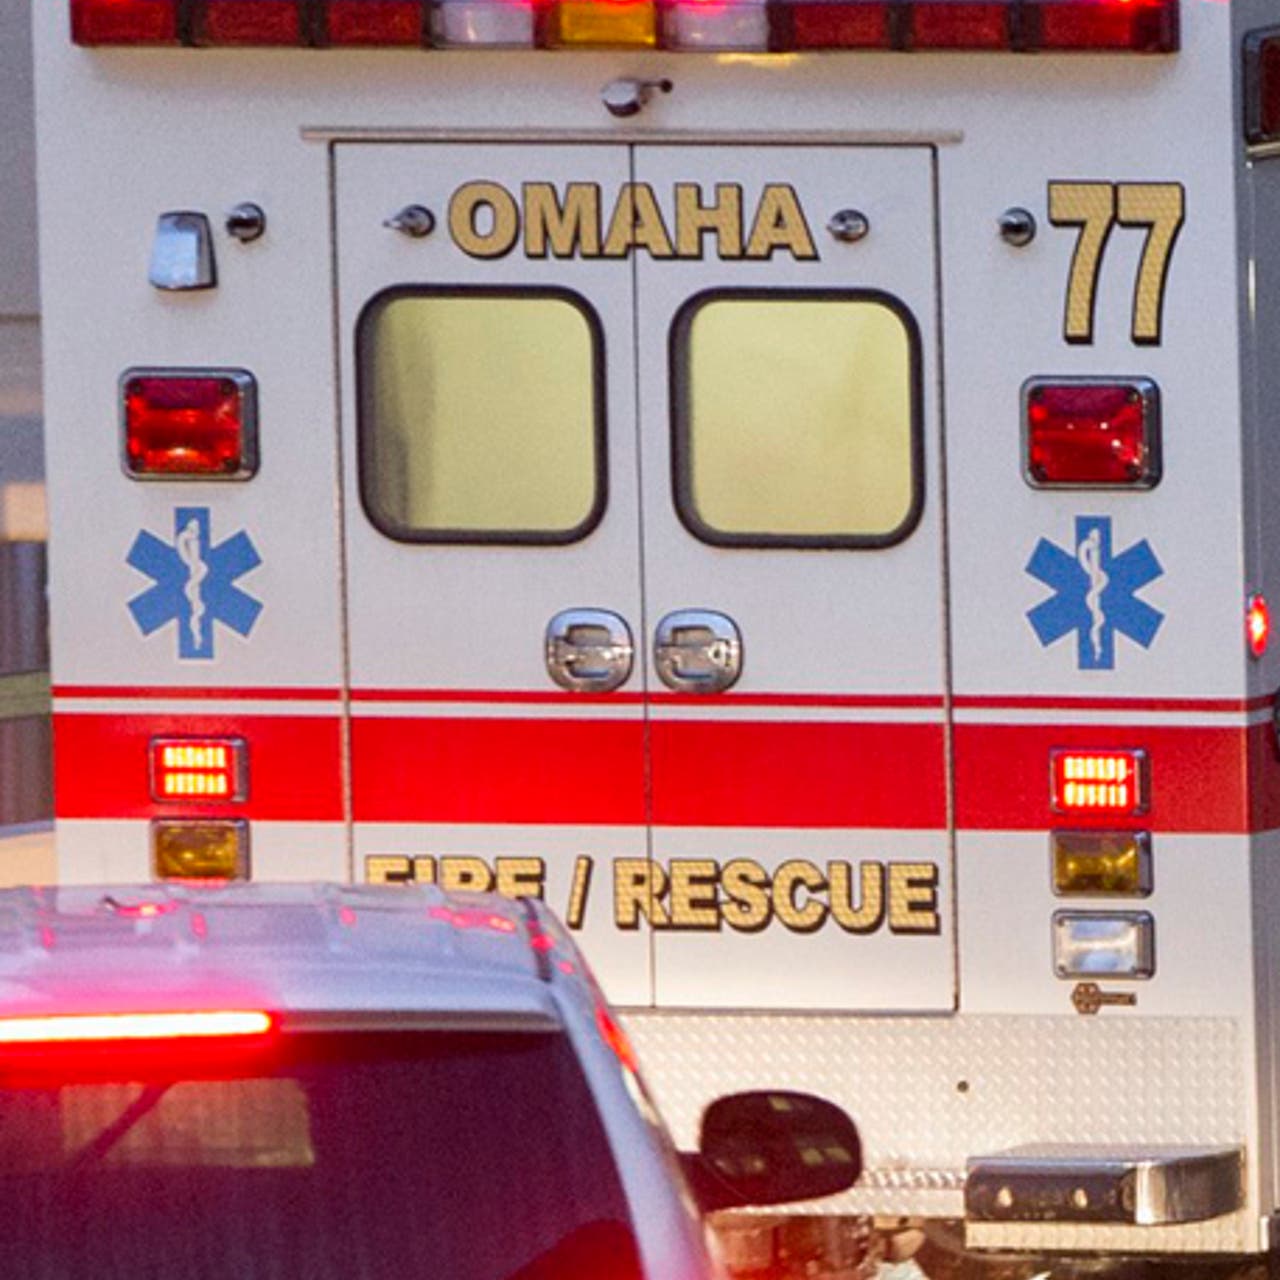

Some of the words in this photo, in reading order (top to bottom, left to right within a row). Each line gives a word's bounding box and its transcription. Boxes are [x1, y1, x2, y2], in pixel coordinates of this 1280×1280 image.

[447, 180, 820, 261] OMAHA
[1047, 179, 1185, 346] 77
[566, 855, 594, 930] /
[613, 858, 941, 935] RESCUE
